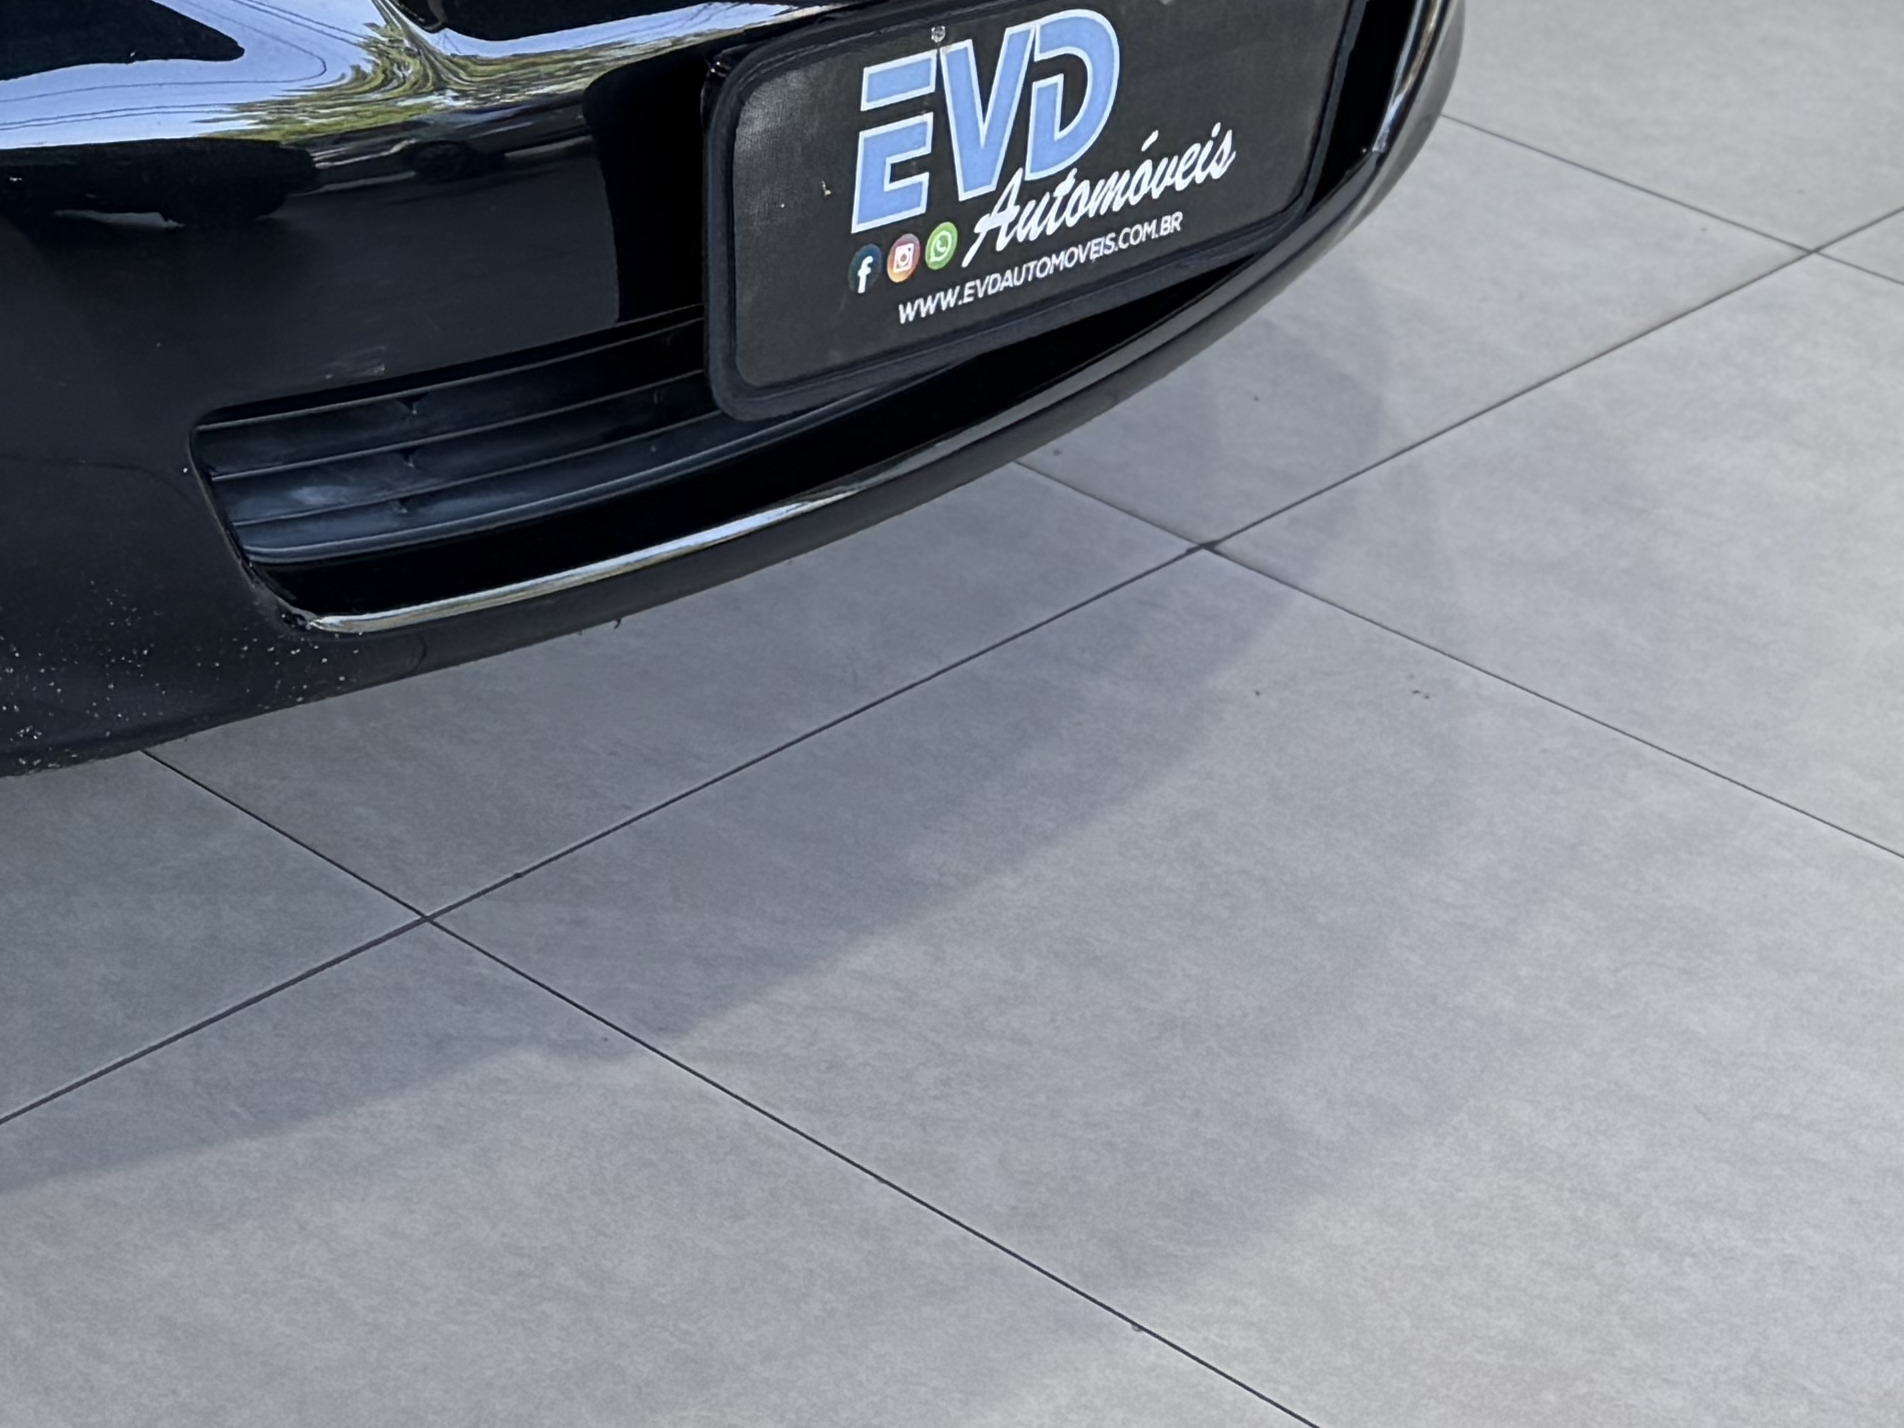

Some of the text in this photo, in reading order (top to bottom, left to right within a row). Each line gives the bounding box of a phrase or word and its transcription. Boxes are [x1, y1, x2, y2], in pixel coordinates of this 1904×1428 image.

[850, 8, 1121, 234] EVD
[961, 121, 1237, 268] Automóveis
[897, 210, 1184, 325] WWW.EVDAUTOMOVEIS.COM.BR
